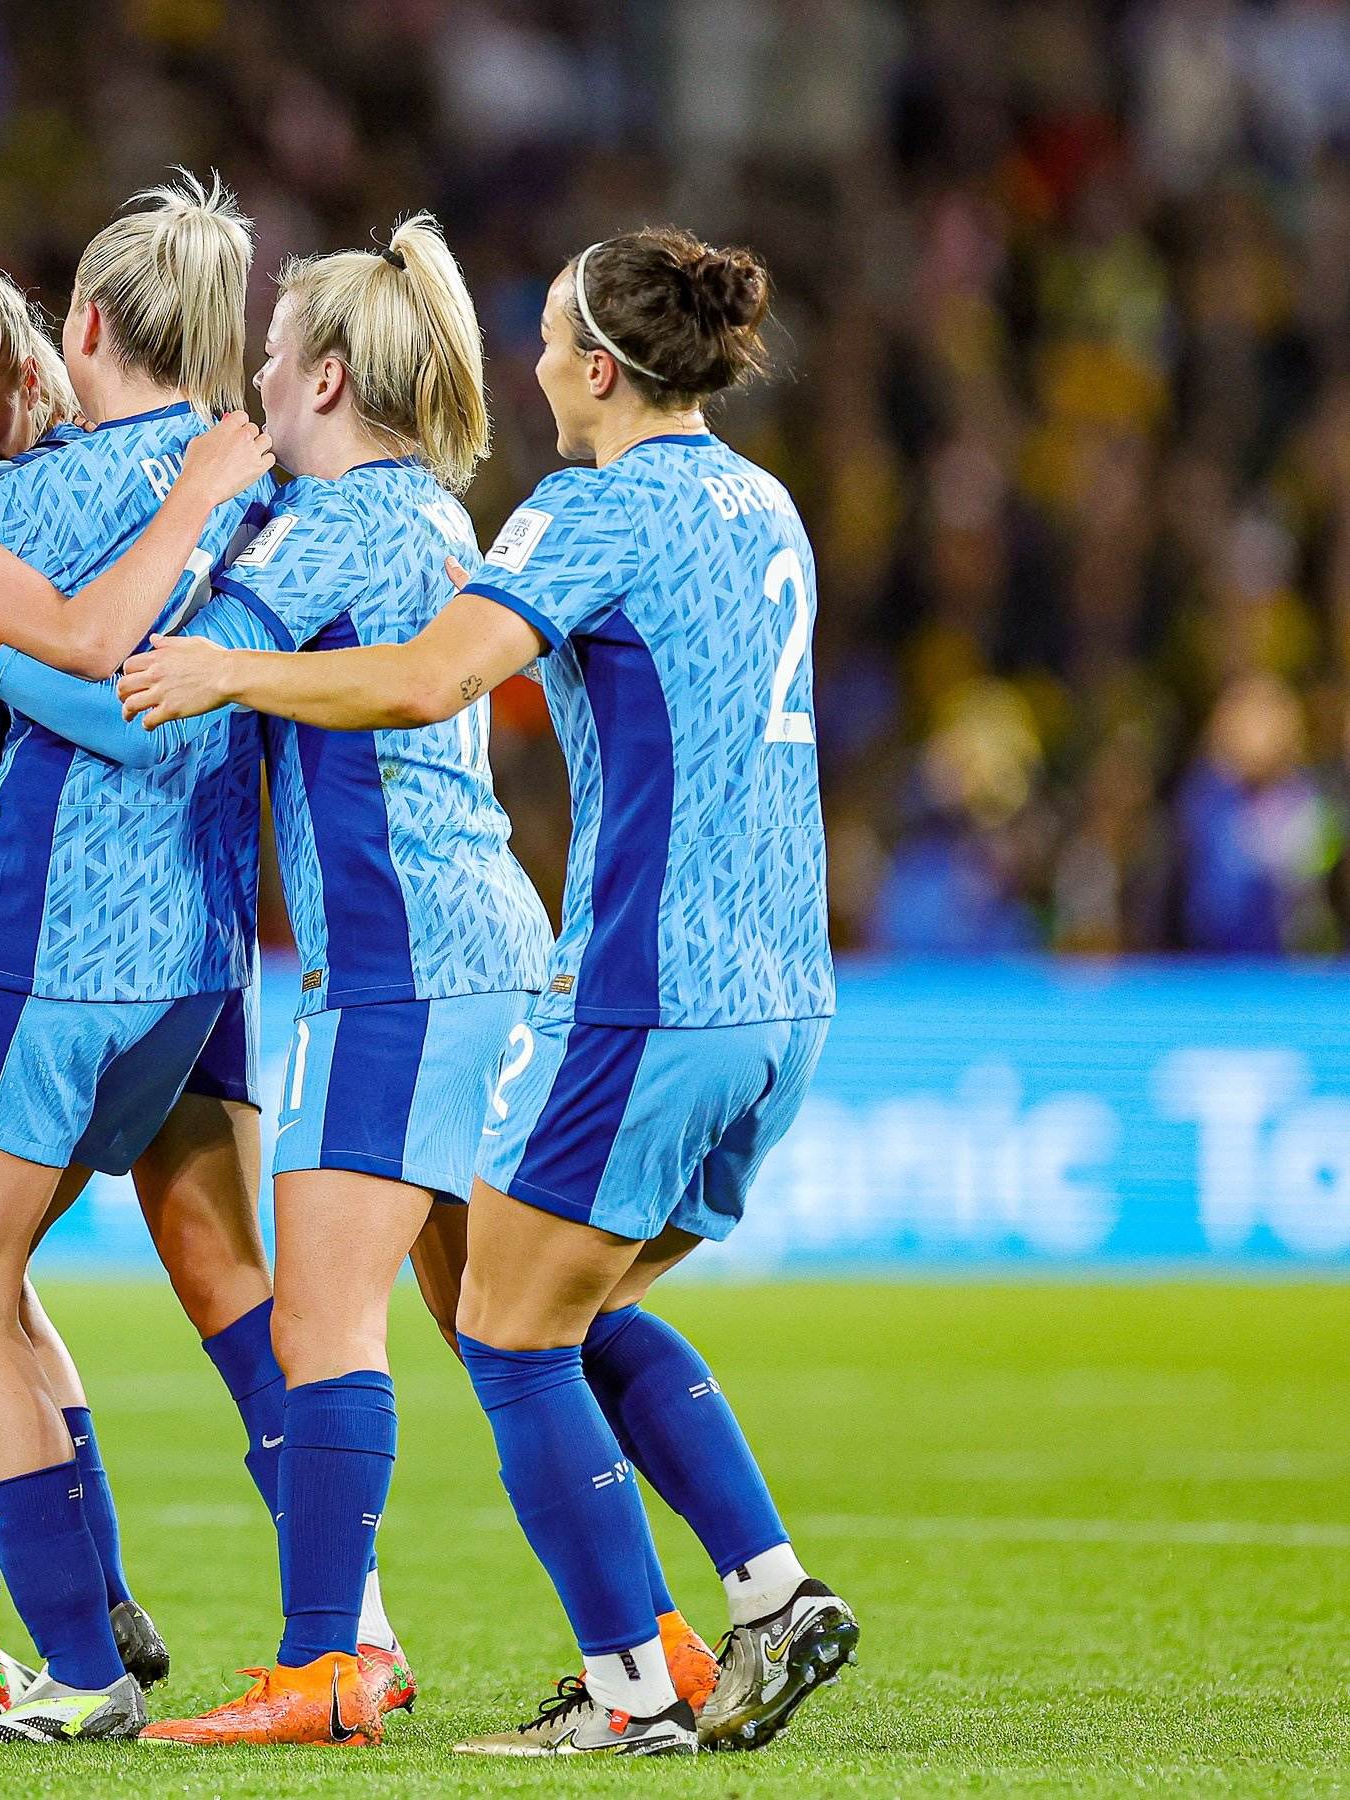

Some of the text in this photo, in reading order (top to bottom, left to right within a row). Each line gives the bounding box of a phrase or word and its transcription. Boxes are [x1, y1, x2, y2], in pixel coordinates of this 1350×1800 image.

[139, 451, 184, 502] RU
[763, 547, 816, 744] 2
[492, 1023, 534, 1121] 2
